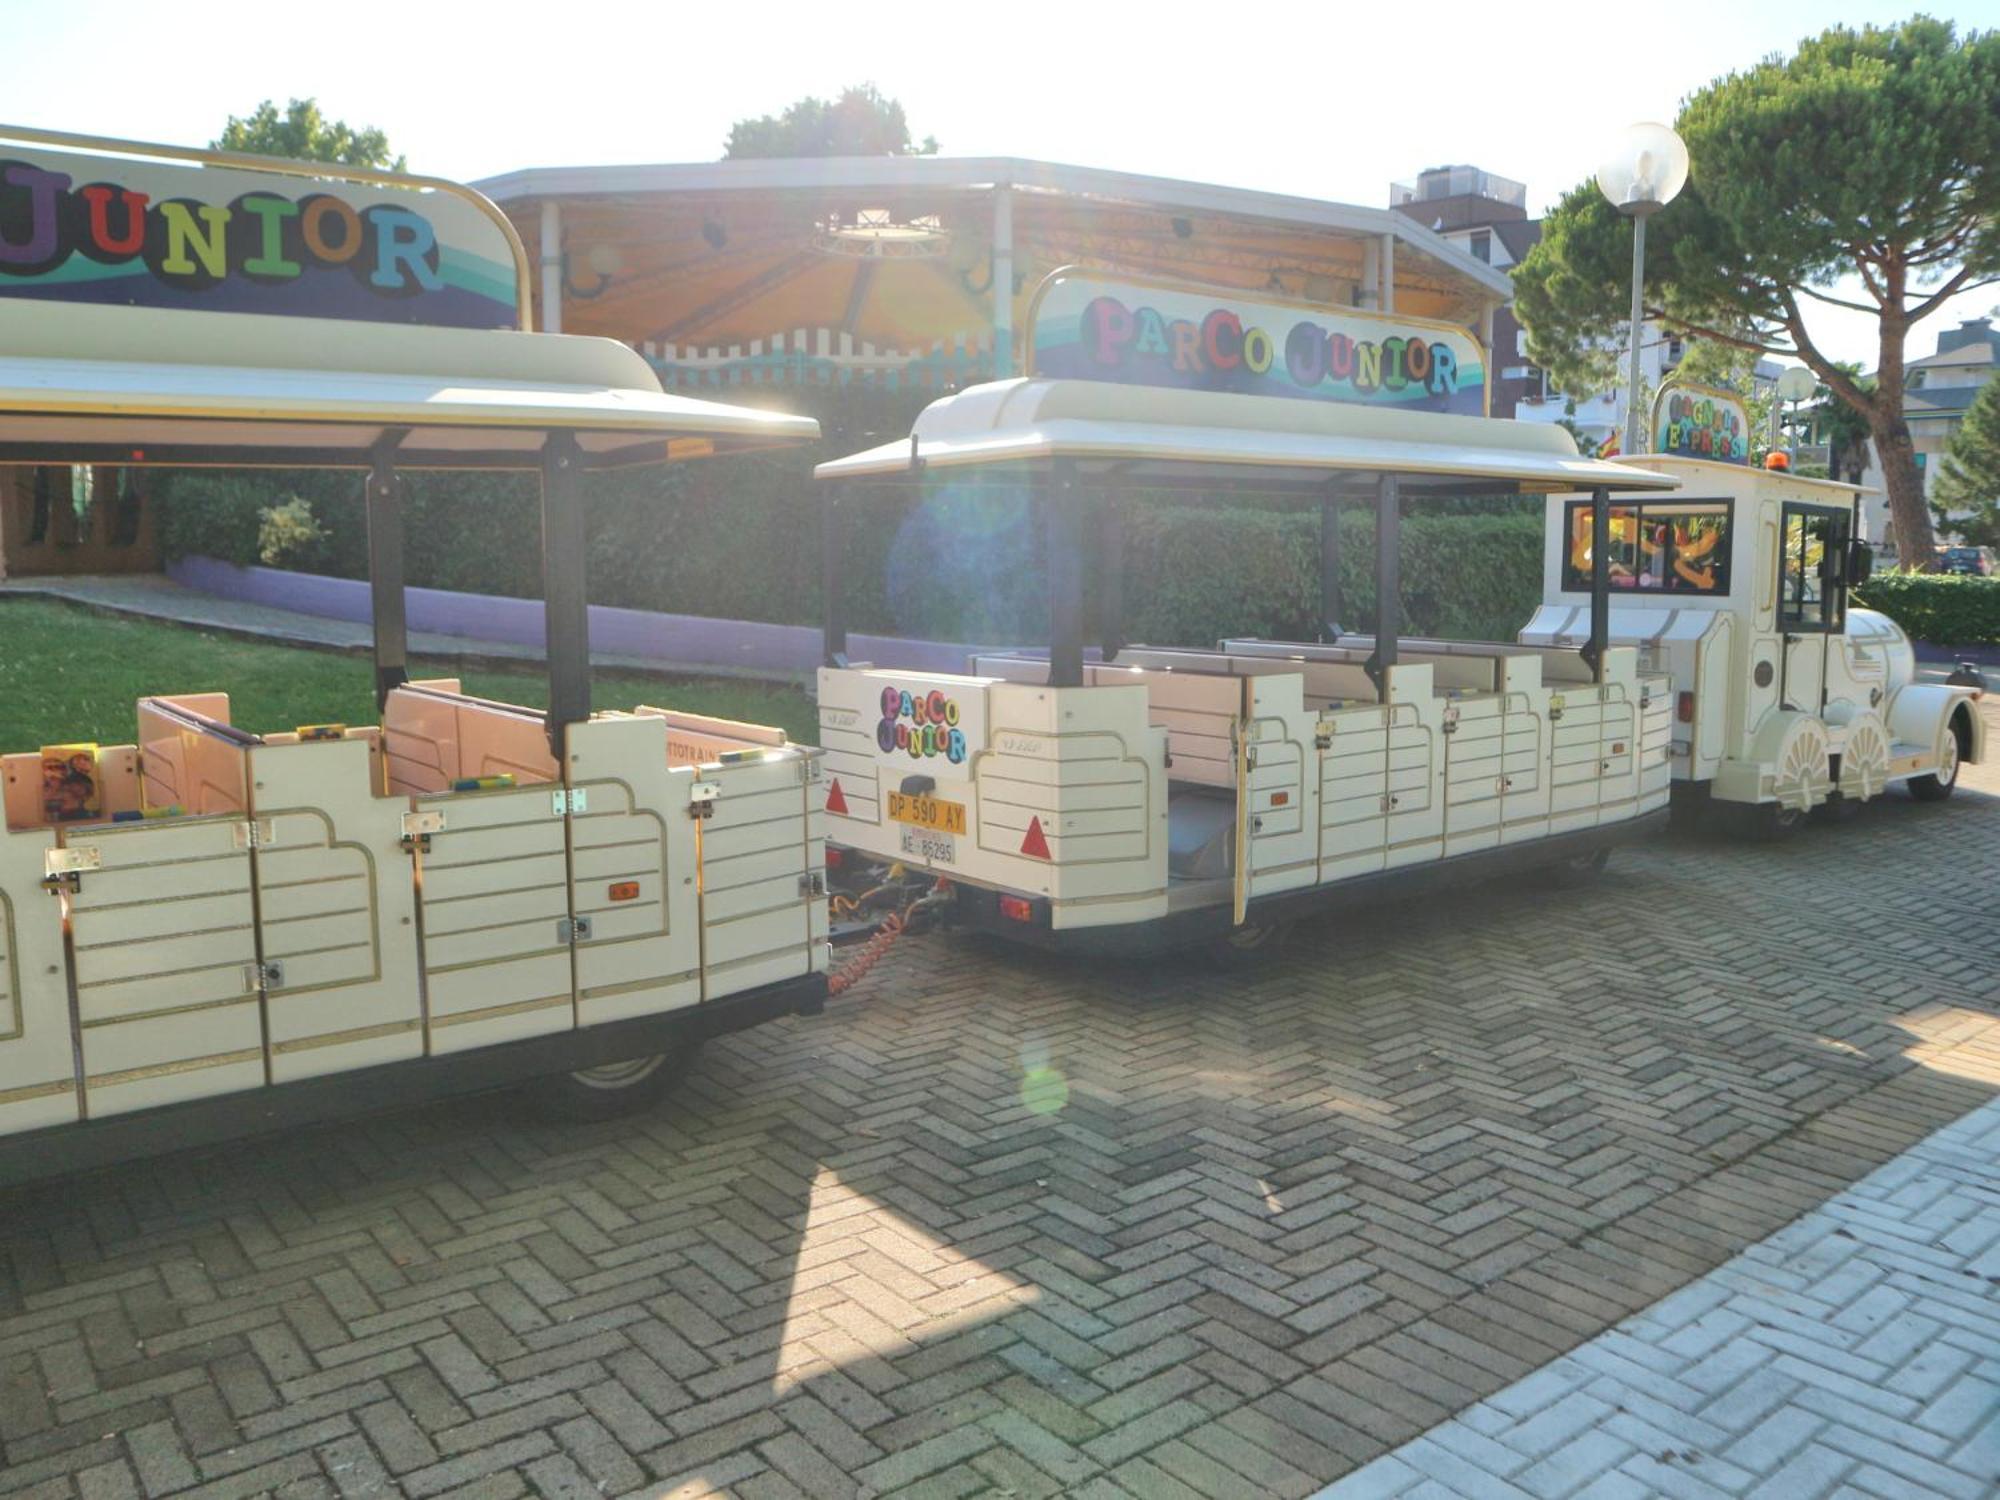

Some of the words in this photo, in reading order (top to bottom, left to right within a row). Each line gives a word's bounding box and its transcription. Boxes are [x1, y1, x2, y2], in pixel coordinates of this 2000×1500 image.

[0, 165, 444, 292] JUNIOR
[1083, 298, 1274, 374] PARCO
[1286, 322, 1458, 396] JUNIOR
[1668, 424, 1741, 459] EXPRESS
[881, 687, 960, 726] PARCO
[877, 718, 967, 764] JUNIOR
[890, 793, 906, 818] DP
[912, 798, 938, 825] 590
[946, 803, 963, 831] AY
